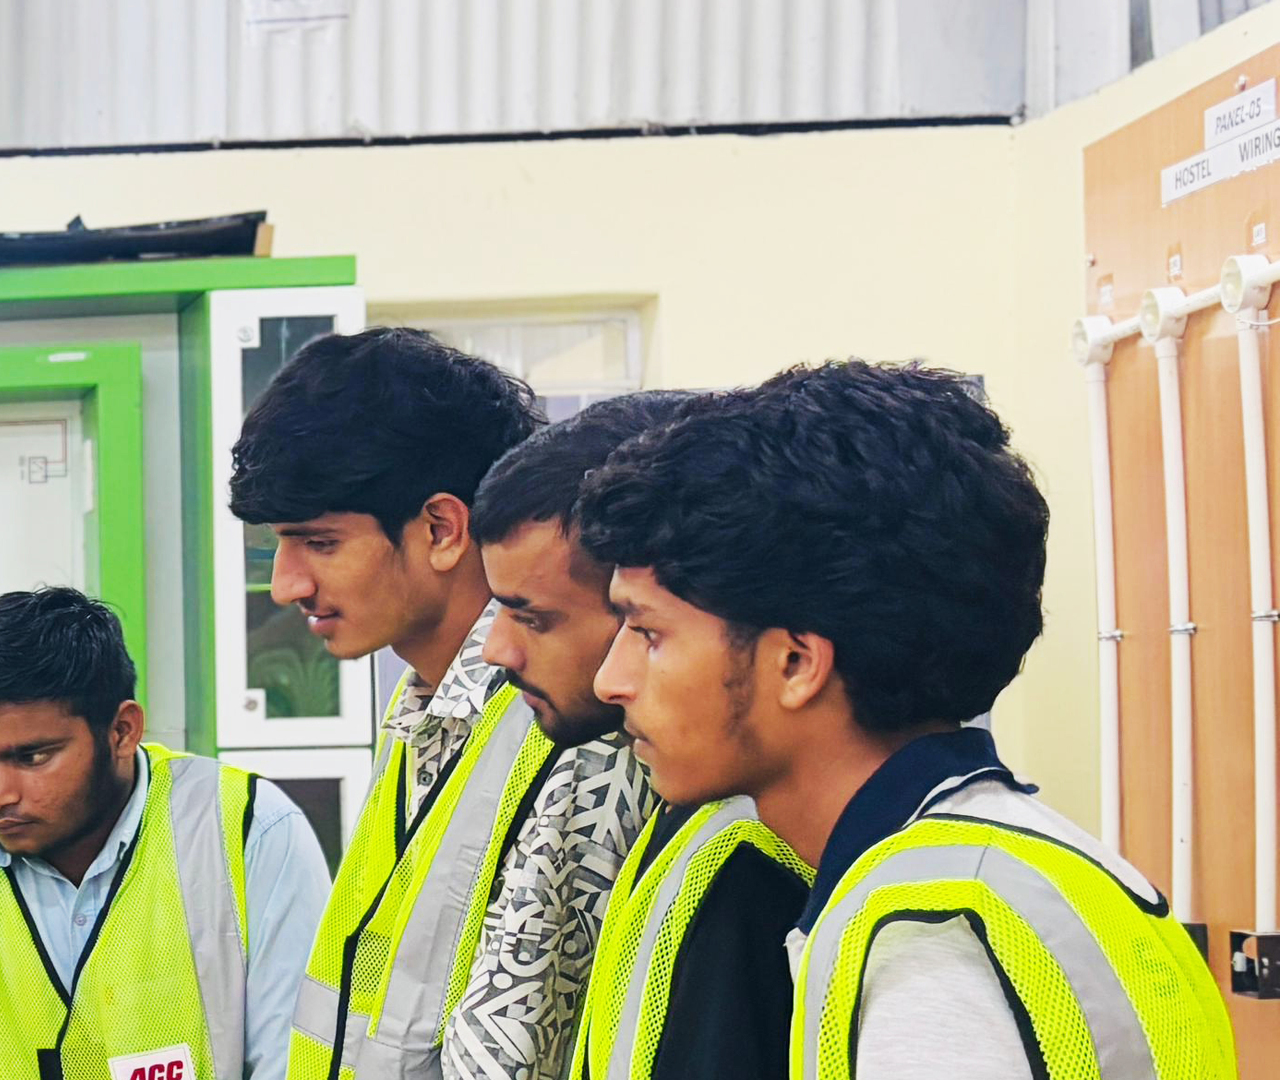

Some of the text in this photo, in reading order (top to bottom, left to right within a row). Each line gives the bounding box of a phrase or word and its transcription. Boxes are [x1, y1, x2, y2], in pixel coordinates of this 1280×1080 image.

[1214, 97, 1262, 136] PANEL-05
[1174, 127, 1280, 190] HOSTEL WIRING
